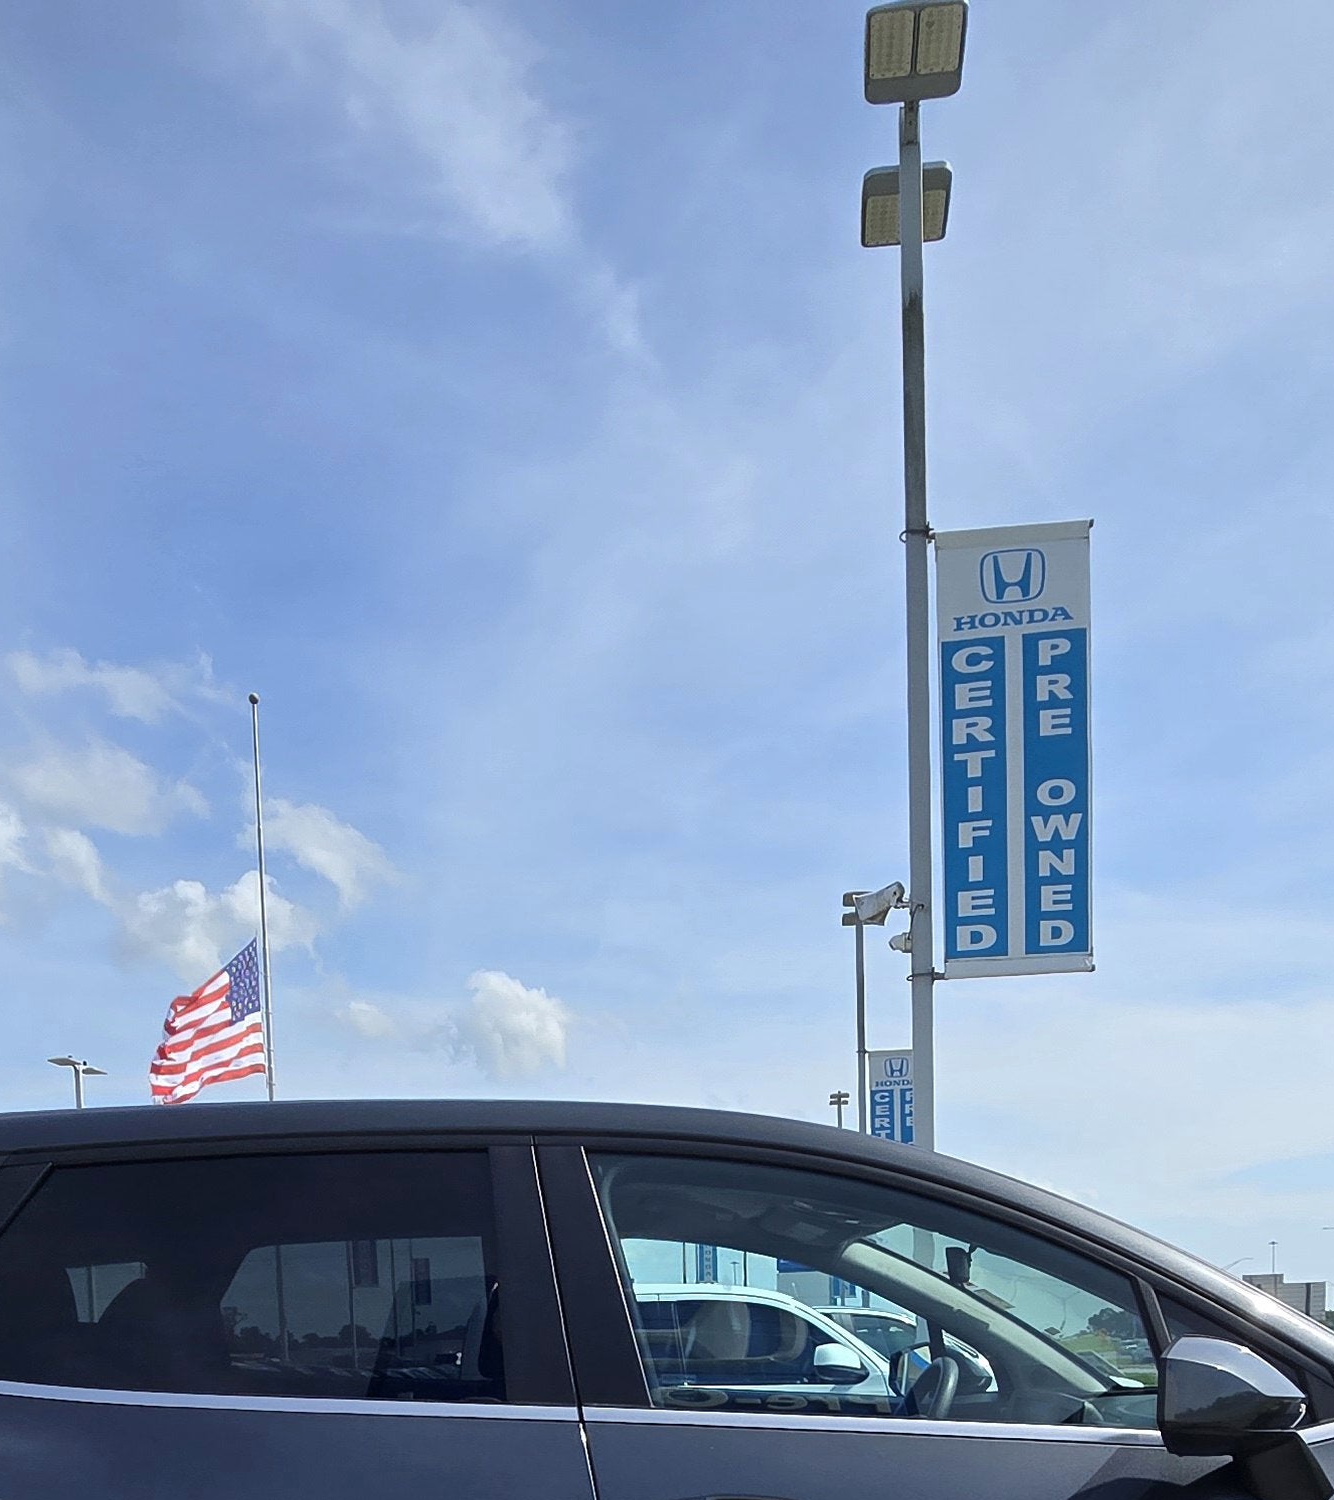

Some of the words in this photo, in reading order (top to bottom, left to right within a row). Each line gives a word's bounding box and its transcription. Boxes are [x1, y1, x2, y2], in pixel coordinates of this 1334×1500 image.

[953, 606, 1073, 632] HONDA
[1036, 638, 1074, 737] PRE
[951, 646, 997, 952] CERTIFIED
[1030, 779, 1082, 946] OWNED
